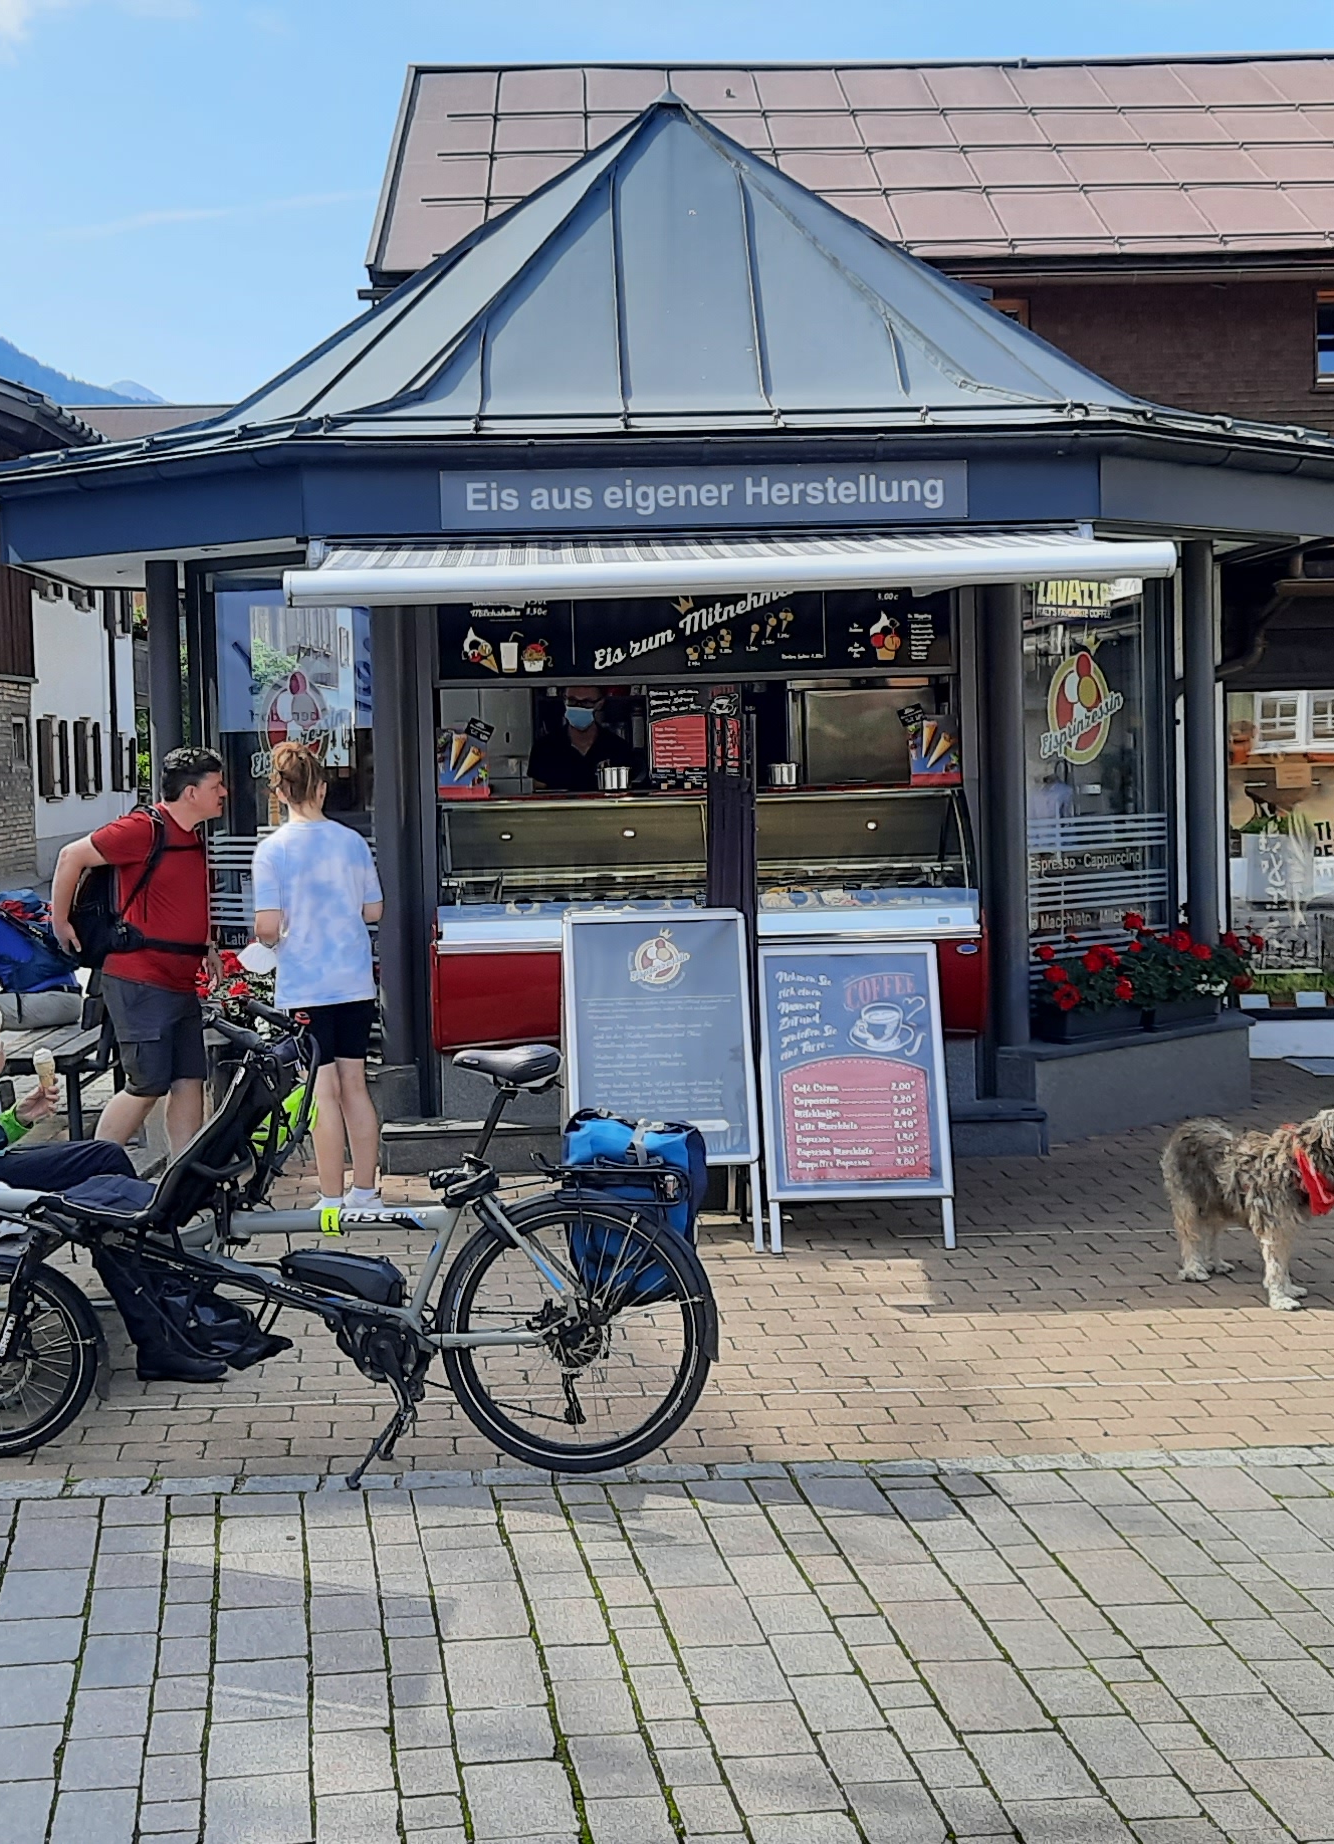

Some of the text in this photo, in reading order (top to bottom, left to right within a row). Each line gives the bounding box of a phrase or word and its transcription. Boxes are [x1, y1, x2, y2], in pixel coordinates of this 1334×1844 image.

[466, 474, 944, 517] Eis aus eigener Herstellung
[1037, 580, 1112, 607] LAVAZZA
[593, 647, 628, 670] Eis
[629, 629, 676, 658] zum
[1042, 692, 1123, 758] Eisprinzessin
[1028, 850, 1142, 874] Espresso Cappuccino
[1041, 912, 1092, 930] Macchiato
[845, 975, 916, 1010] COFFEE
[339, 1211, 394, 1222] ASE
